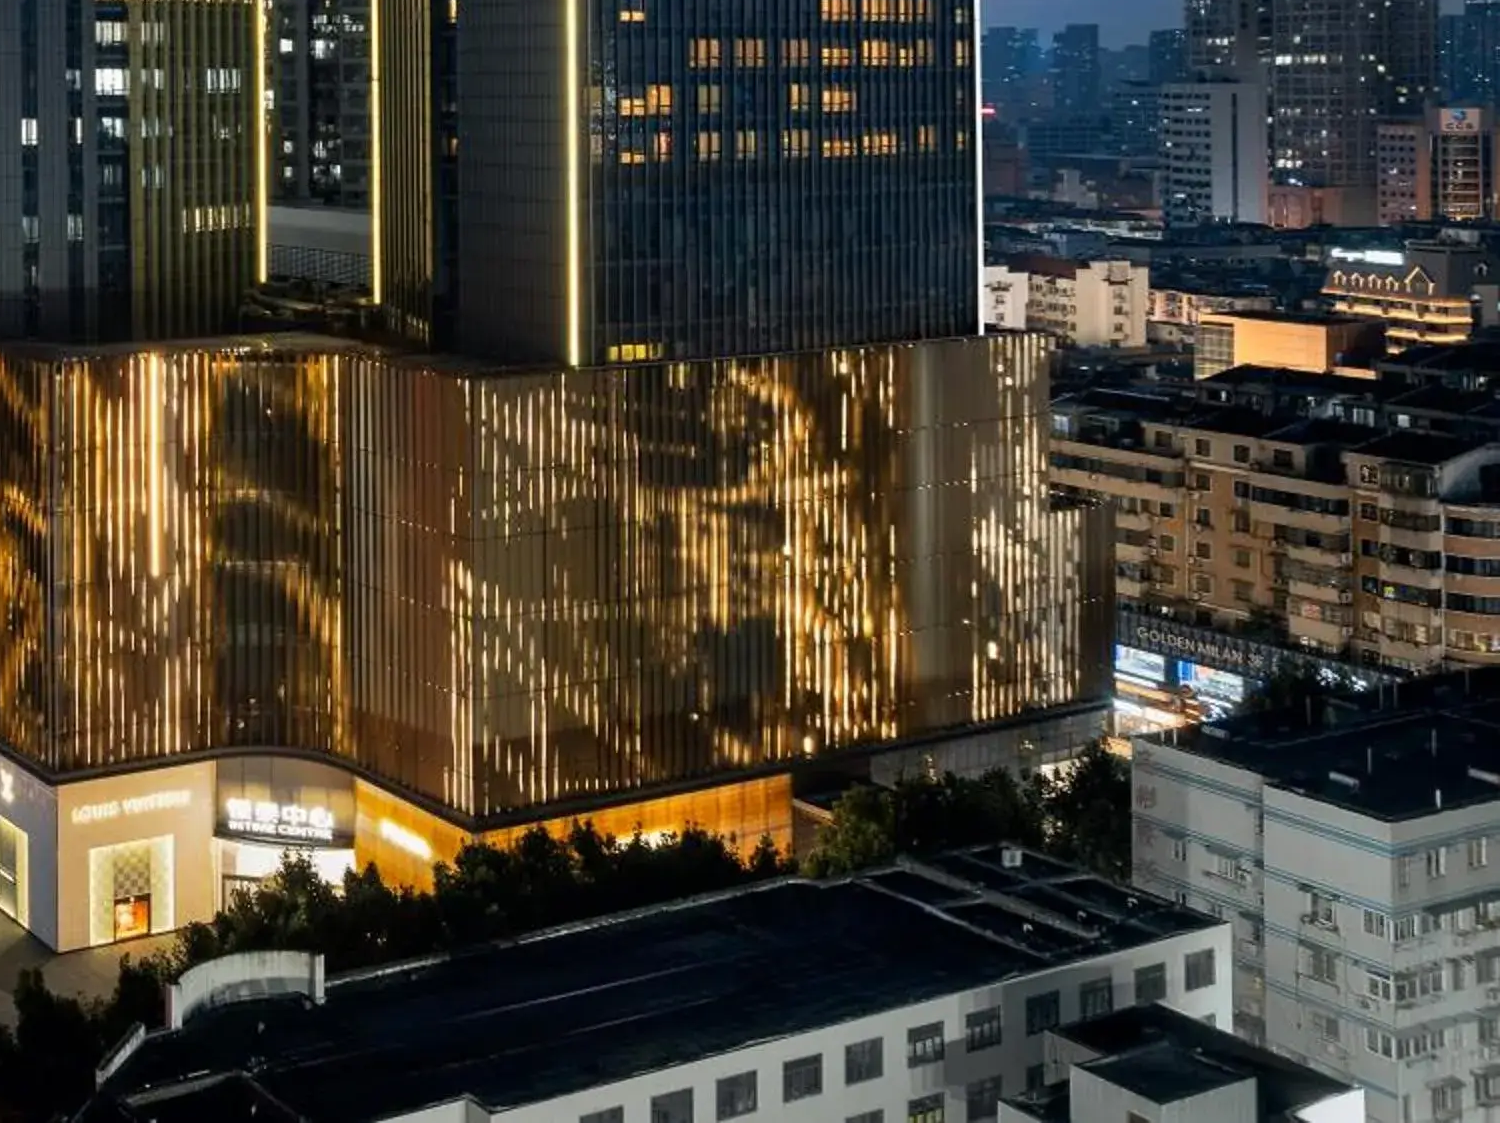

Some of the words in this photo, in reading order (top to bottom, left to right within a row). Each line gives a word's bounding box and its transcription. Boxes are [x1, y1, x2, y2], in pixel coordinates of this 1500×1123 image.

[1137, 626, 1196, 653] GOLDEN
[1197, 642, 1243, 664] MILAN
[71, 800, 120, 825] LOUIS
